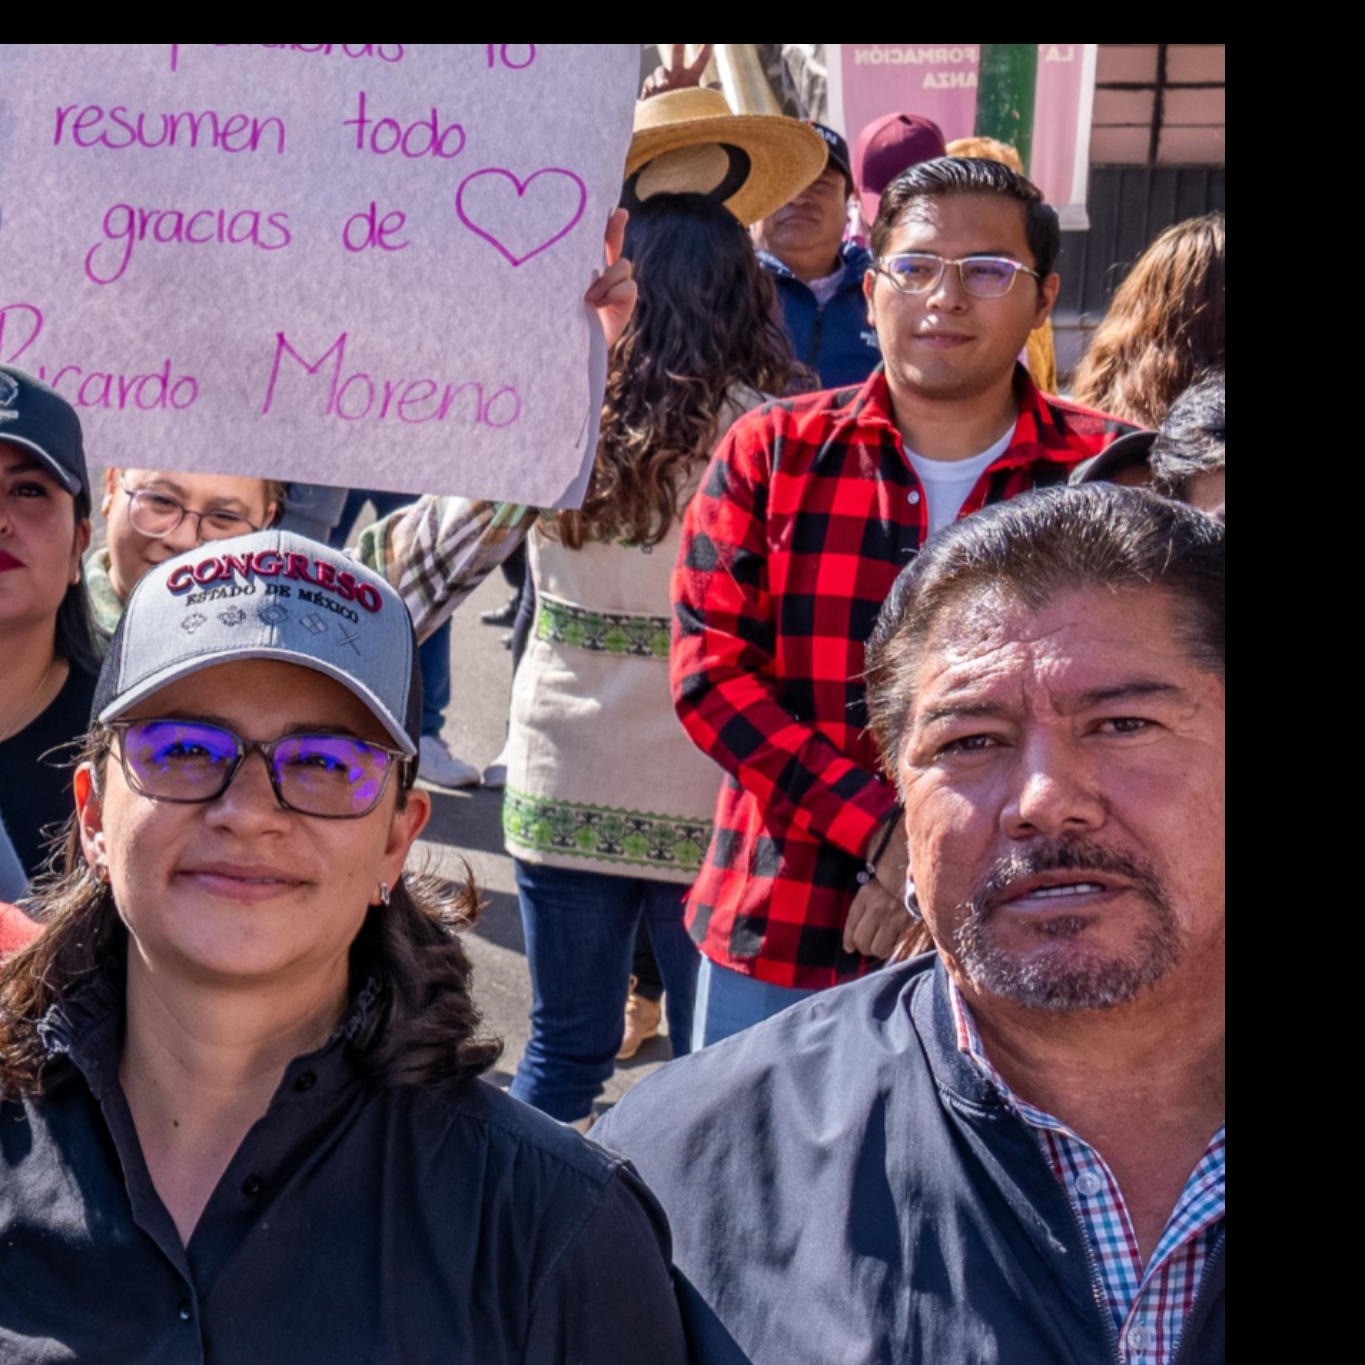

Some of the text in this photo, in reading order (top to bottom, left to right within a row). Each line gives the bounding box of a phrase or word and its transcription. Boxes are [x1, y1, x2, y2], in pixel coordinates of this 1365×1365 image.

[52, 91, 467, 159] resumen todo
[84, 201, 412, 284] gracias de
[261, 331, 523, 428] Moreno
[166, 549, 384, 614] CONGRESO
[185, 583, 360, 625] ESTADO DE MÉXICO
